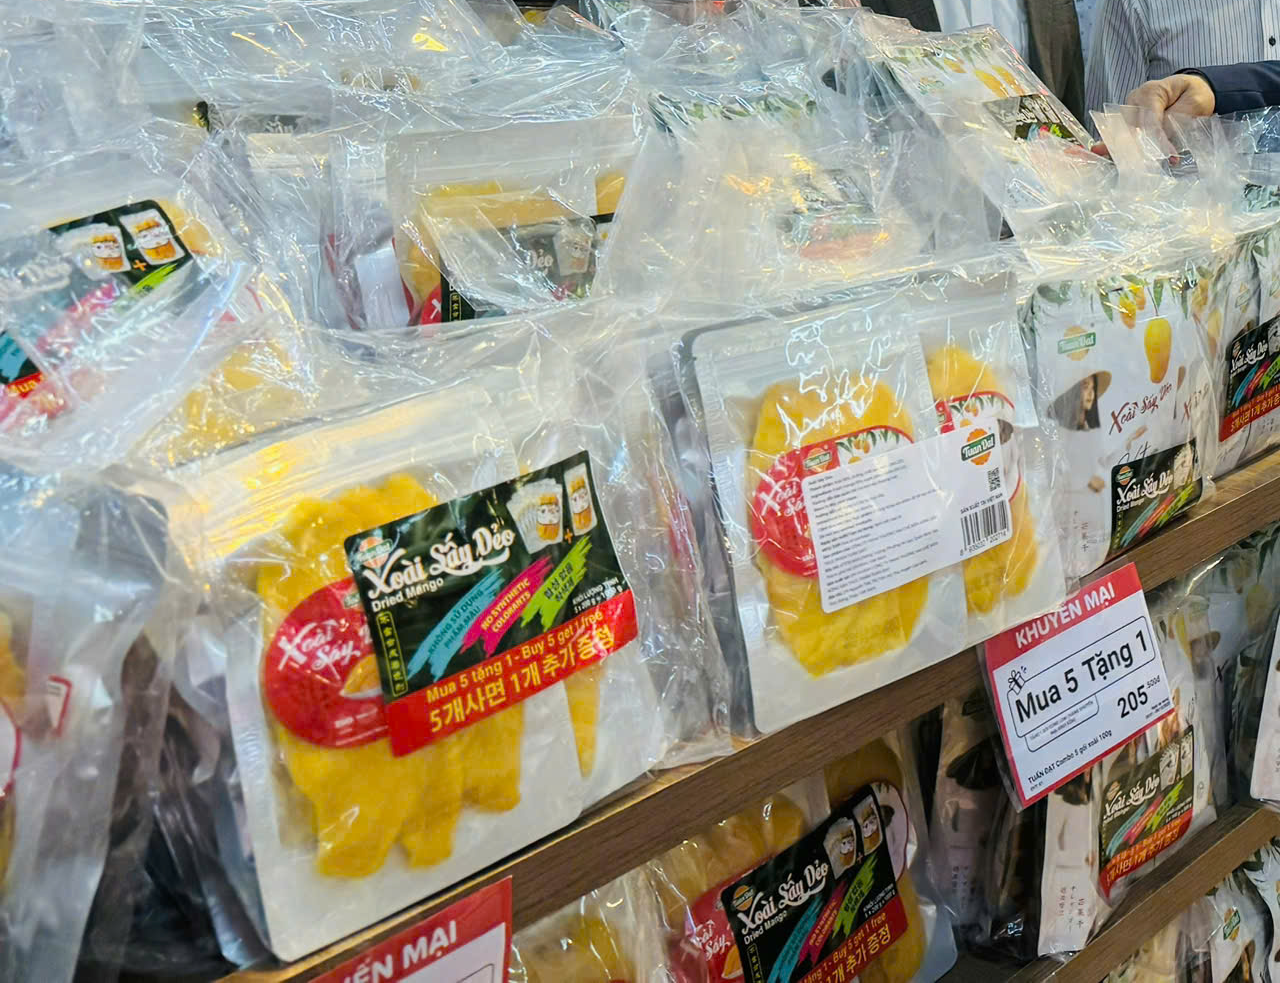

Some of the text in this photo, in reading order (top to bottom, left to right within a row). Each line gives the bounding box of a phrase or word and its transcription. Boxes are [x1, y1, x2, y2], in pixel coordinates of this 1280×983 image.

[963, 439, 982, 458] Tuan
[1116, 478, 1141, 505] Xoài
[1141, 472, 1160, 499] Sấy
[362, 521, 516, 599] Xoài Sấy Dẻo
[371, 577, 444, 613] Dried Mango
[1015, 580, 1117, 649] KHUYẾN MẠI
[278, 619, 338, 671] Xoài
[481, 616, 494, 631] NO
[426, 681, 457, 703] Mua
[460, 675, 469, 689] 5
[471, 661, 503, 684] tặng
[505, 654, 513, 668] 1
[521, 640, 545, 660] Buy
[547, 633, 556, 647] 5
[557, 623, 576, 643] get
[430, 678, 506, 733] 5개사면
[510, 661, 542, 694] 1개
[543, 643, 576, 678] 추가
[1015, 682, 1063, 723] Mua
[1064, 668, 1079, 694] 5
[1082, 641, 1134, 681] Tặng
[1135, 630, 1149, 652] 1
[1117, 684, 1149, 719] 205
[737, 891, 778, 934] Xoài
[777, 872, 812, 907] Sấy
[803, 858, 829, 888] Dẻo
[401, 919, 458, 968] MẠI
[743, 910, 788, 945] Dried Mango
[832, 948, 848, 963] Buy
[853, 932, 865, 947] get
[870, 912, 887, 928] free
[846, 944, 867, 974] 추가
[867, 924, 891, 955] 증정
